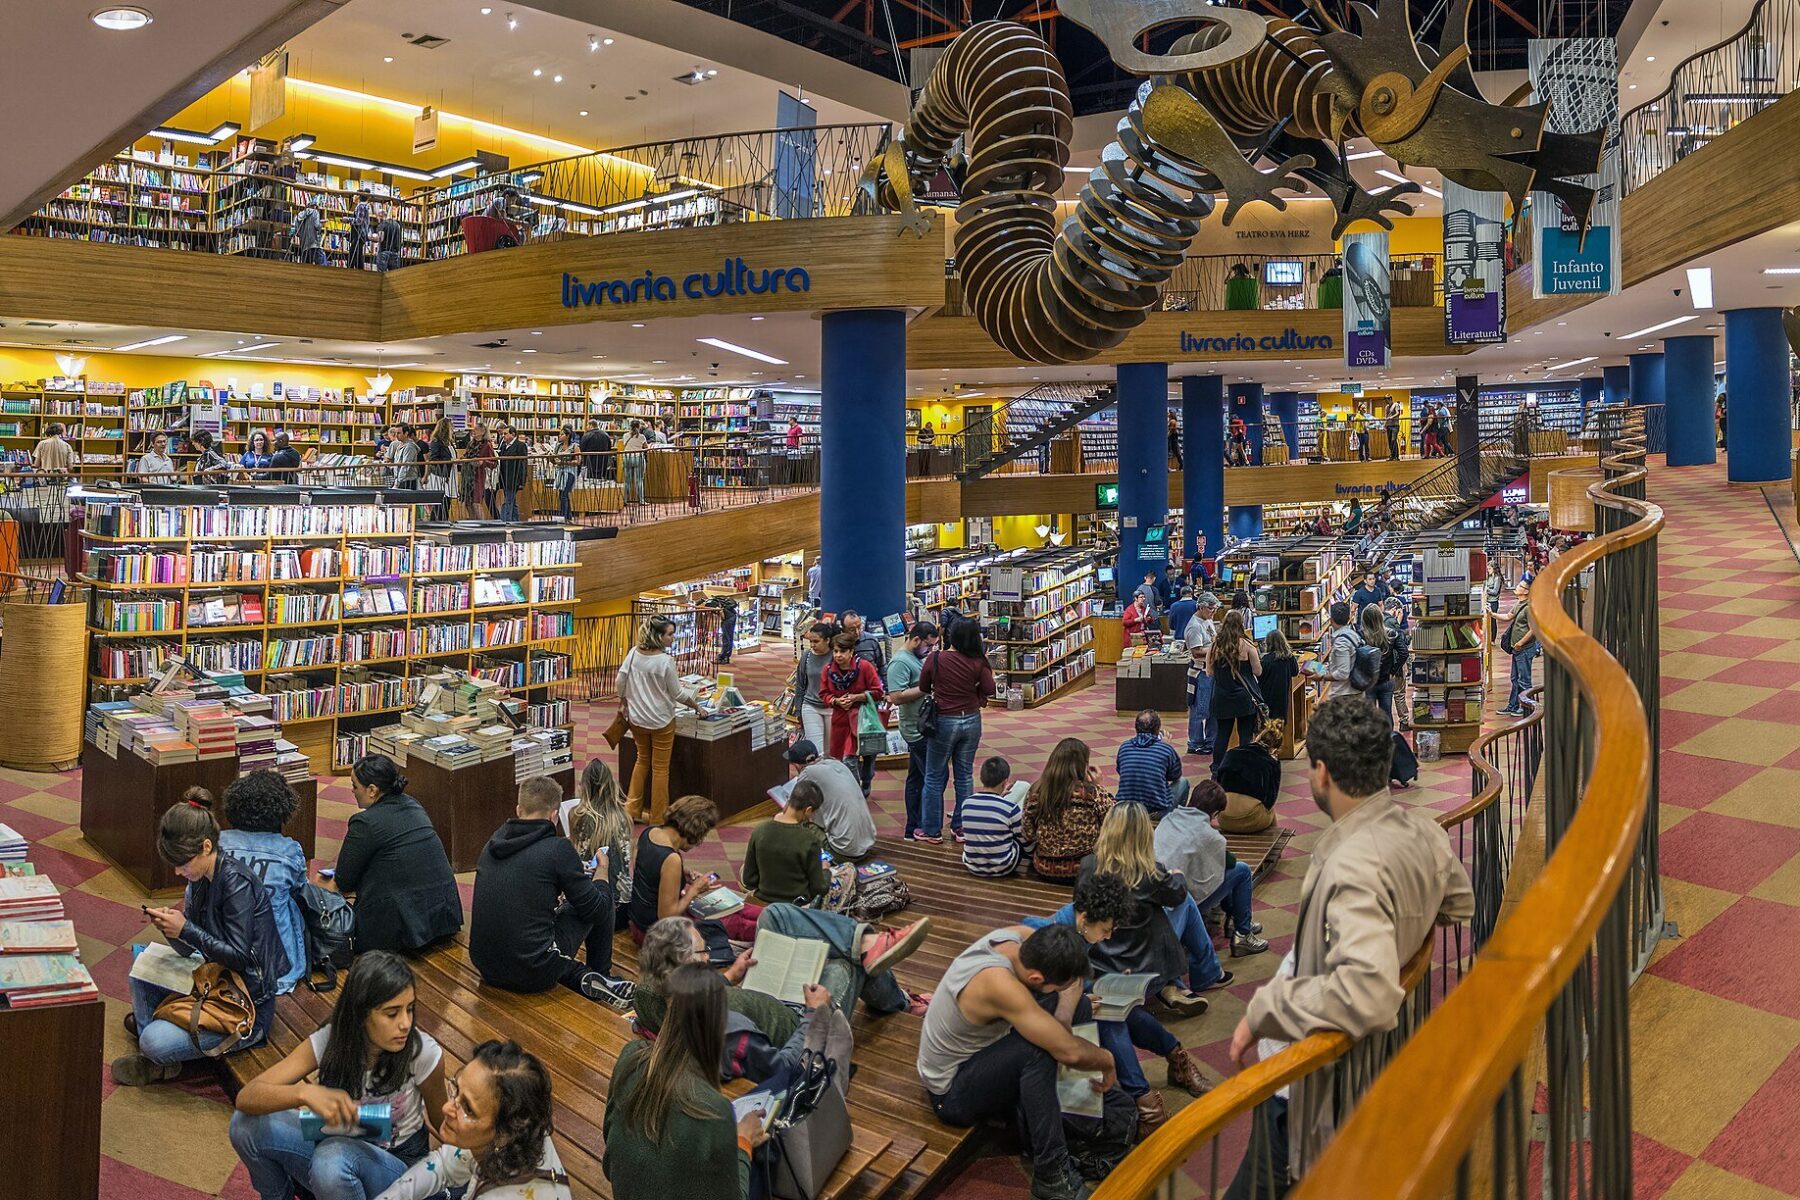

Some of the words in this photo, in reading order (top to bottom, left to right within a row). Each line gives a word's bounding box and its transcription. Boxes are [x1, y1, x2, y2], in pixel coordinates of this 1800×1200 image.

[1235, 231, 1268, 239] TEATRO
[1288, 229, 1310, 238] HERZ
[1552, 259, 1604, 274] Infanto
[562, 270, 677, 308] livraria
[682, 256, 810, 299] cultura
[1552, 276, 1601, 293] Juvenil
[1180, 331, 1256, 353] livraria
[1259, 328, 1334, 350] cultura
[1454, 330, 1498, 340] Literatura
[1358, 350, 1375, 358] CDs
[1356, 357, 1378, 365] DVDs
[1335, 483, 1373, 495] livraria
